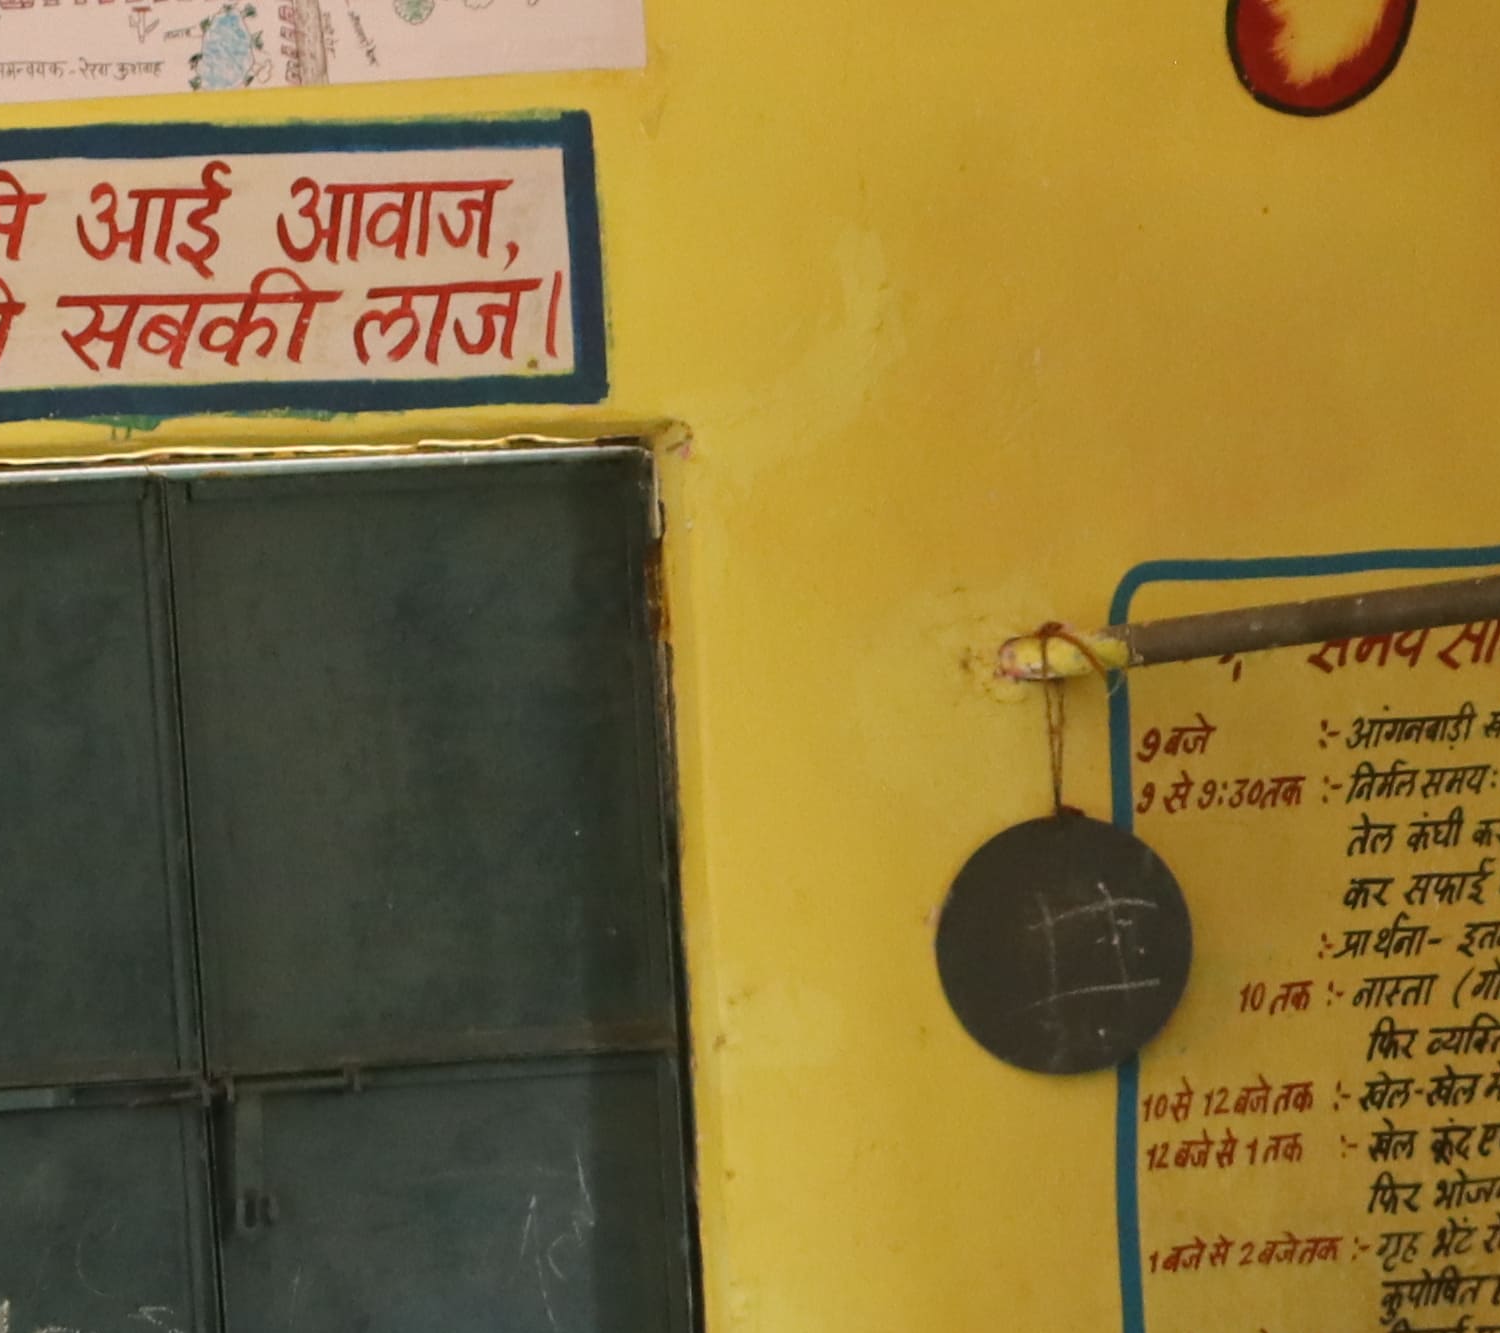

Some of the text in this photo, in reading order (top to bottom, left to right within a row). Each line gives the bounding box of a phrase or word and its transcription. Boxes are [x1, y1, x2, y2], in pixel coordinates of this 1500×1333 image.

[77, 161, 232, 281] आई
[276, 177, 520, 269] आवाज,
[56, 267, 343, 372] सबकी
[1137, 712, 1217, 763] 9 बजे
[1346, 701, 1476, 751] आंगनबाड़ी
[1368, 1171, 1422, 1214] फिर
